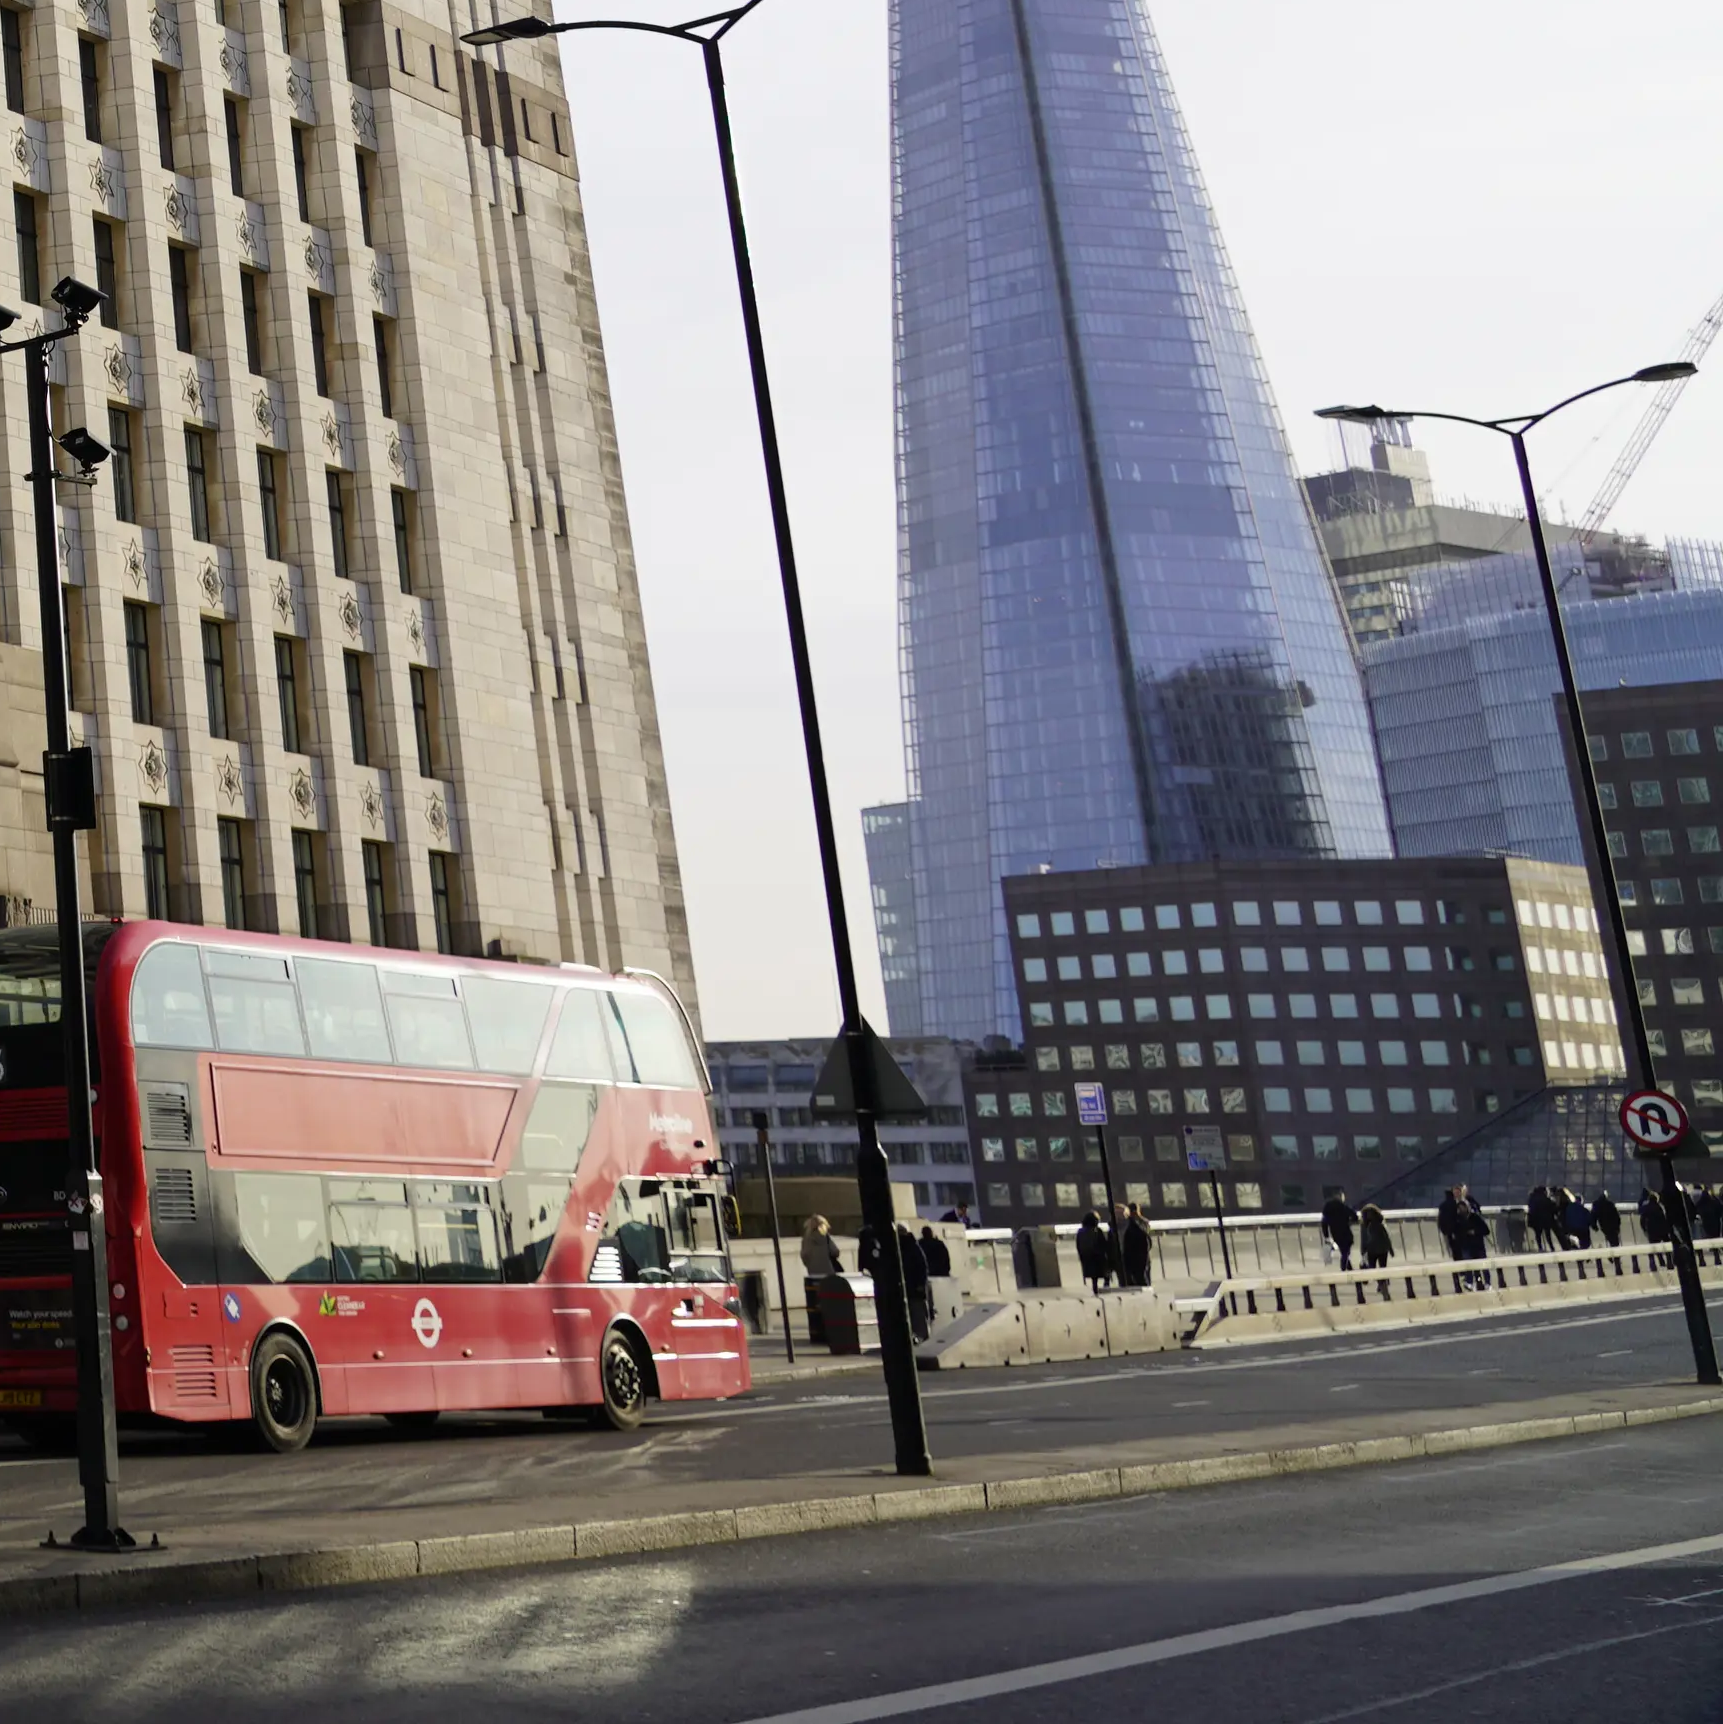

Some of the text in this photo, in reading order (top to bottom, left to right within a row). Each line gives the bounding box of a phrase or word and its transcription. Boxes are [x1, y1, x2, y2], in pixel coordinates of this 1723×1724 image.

[53, 1190, 66, 1201] BD
[8, 1309, 32, 1319] Watch
[33, 1310, 50, 1319] your
